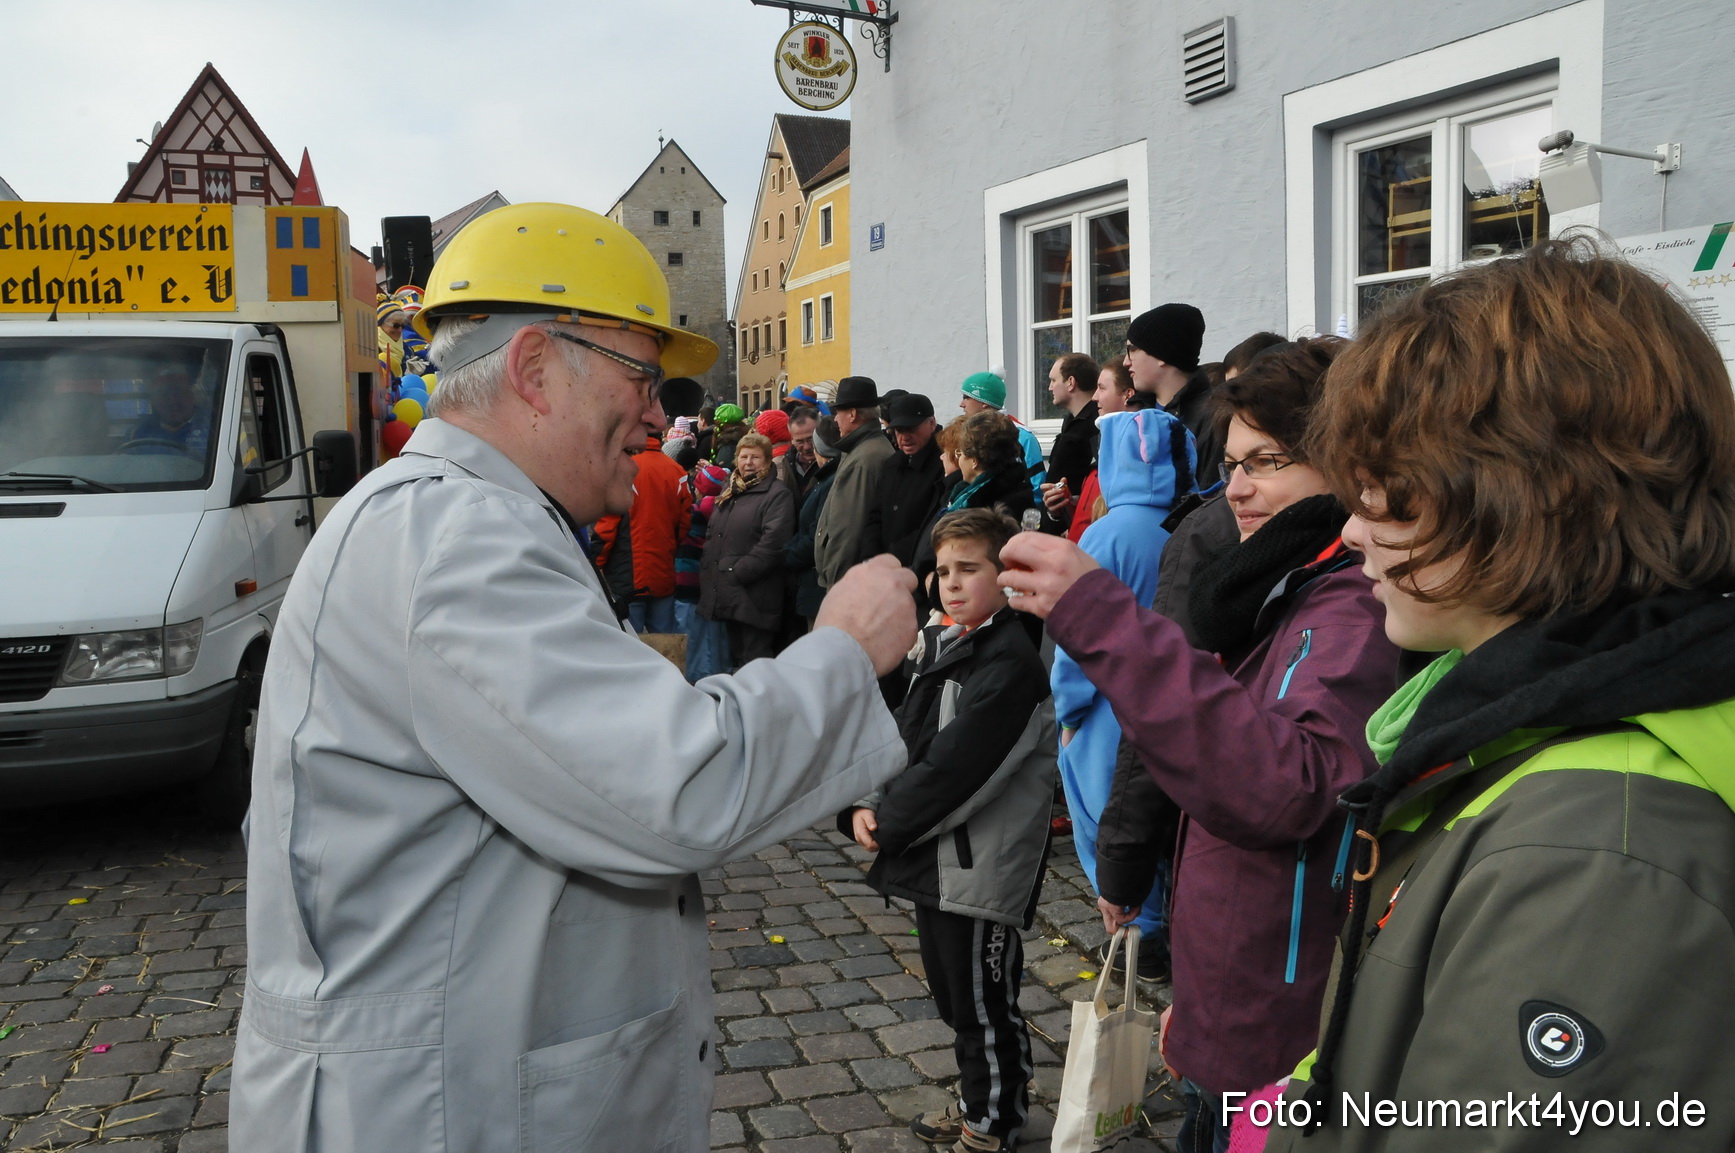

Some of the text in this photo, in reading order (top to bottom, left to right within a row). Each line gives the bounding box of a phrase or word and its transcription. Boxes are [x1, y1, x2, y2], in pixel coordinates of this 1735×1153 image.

[803, 30, 830, 40] WINKLER
[787, 41, 800, 49] SEIT
[798, 87, 835, 99] BERCHING
[1654, 238, 1696, 251] Eisdiele
[161, 276, 191, 304] e.
